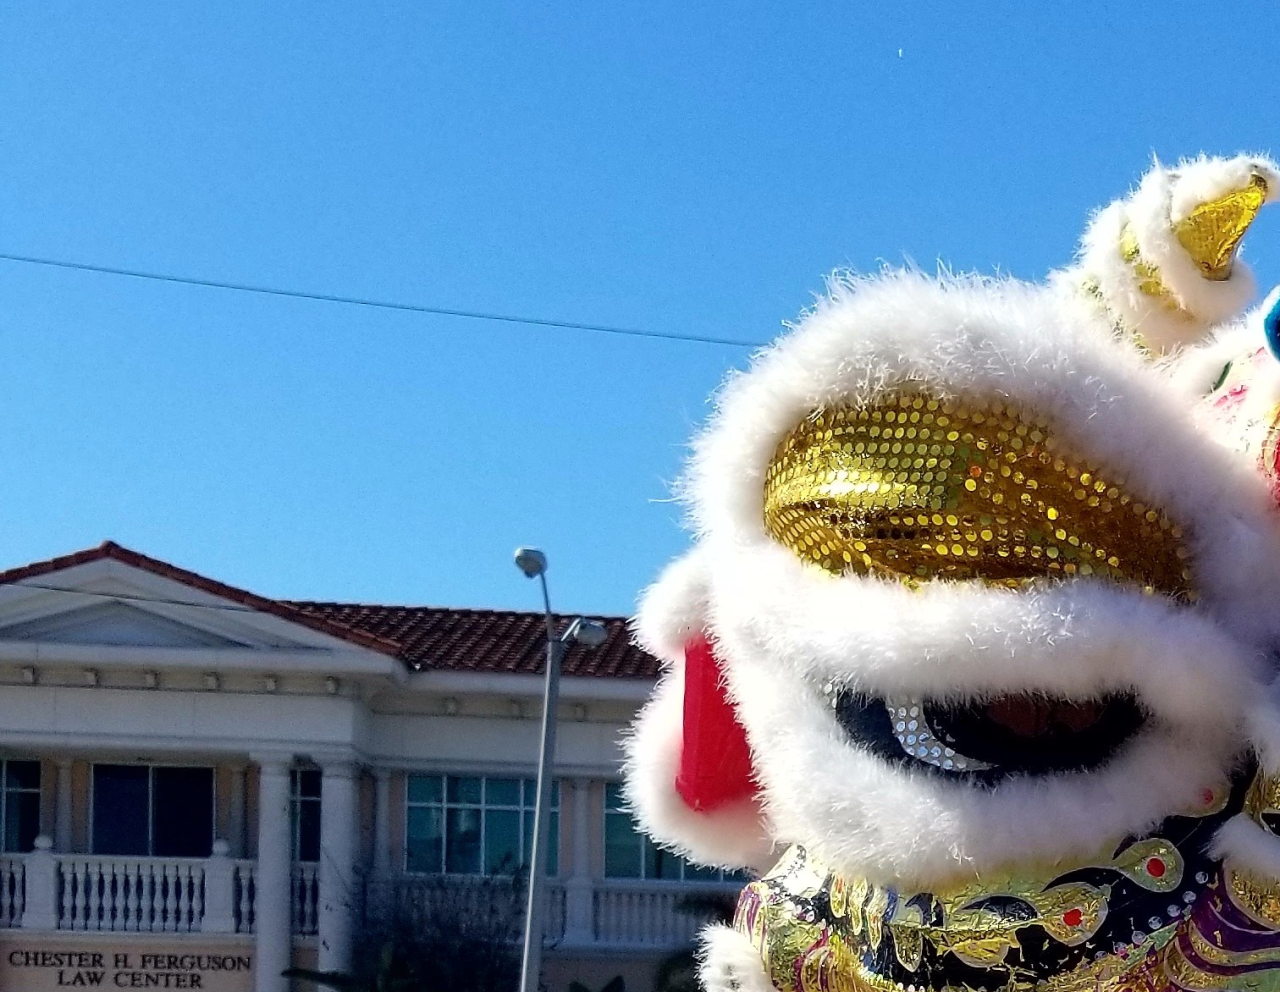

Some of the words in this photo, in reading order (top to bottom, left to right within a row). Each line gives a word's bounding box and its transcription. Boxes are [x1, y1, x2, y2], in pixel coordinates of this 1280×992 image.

[9, 951, 104, 968] CHESTER
[141, 953, 250, 971] FERGUSON
[57, 969, 105, 987] LAW
[114, 971, 204, 989] CENTER
